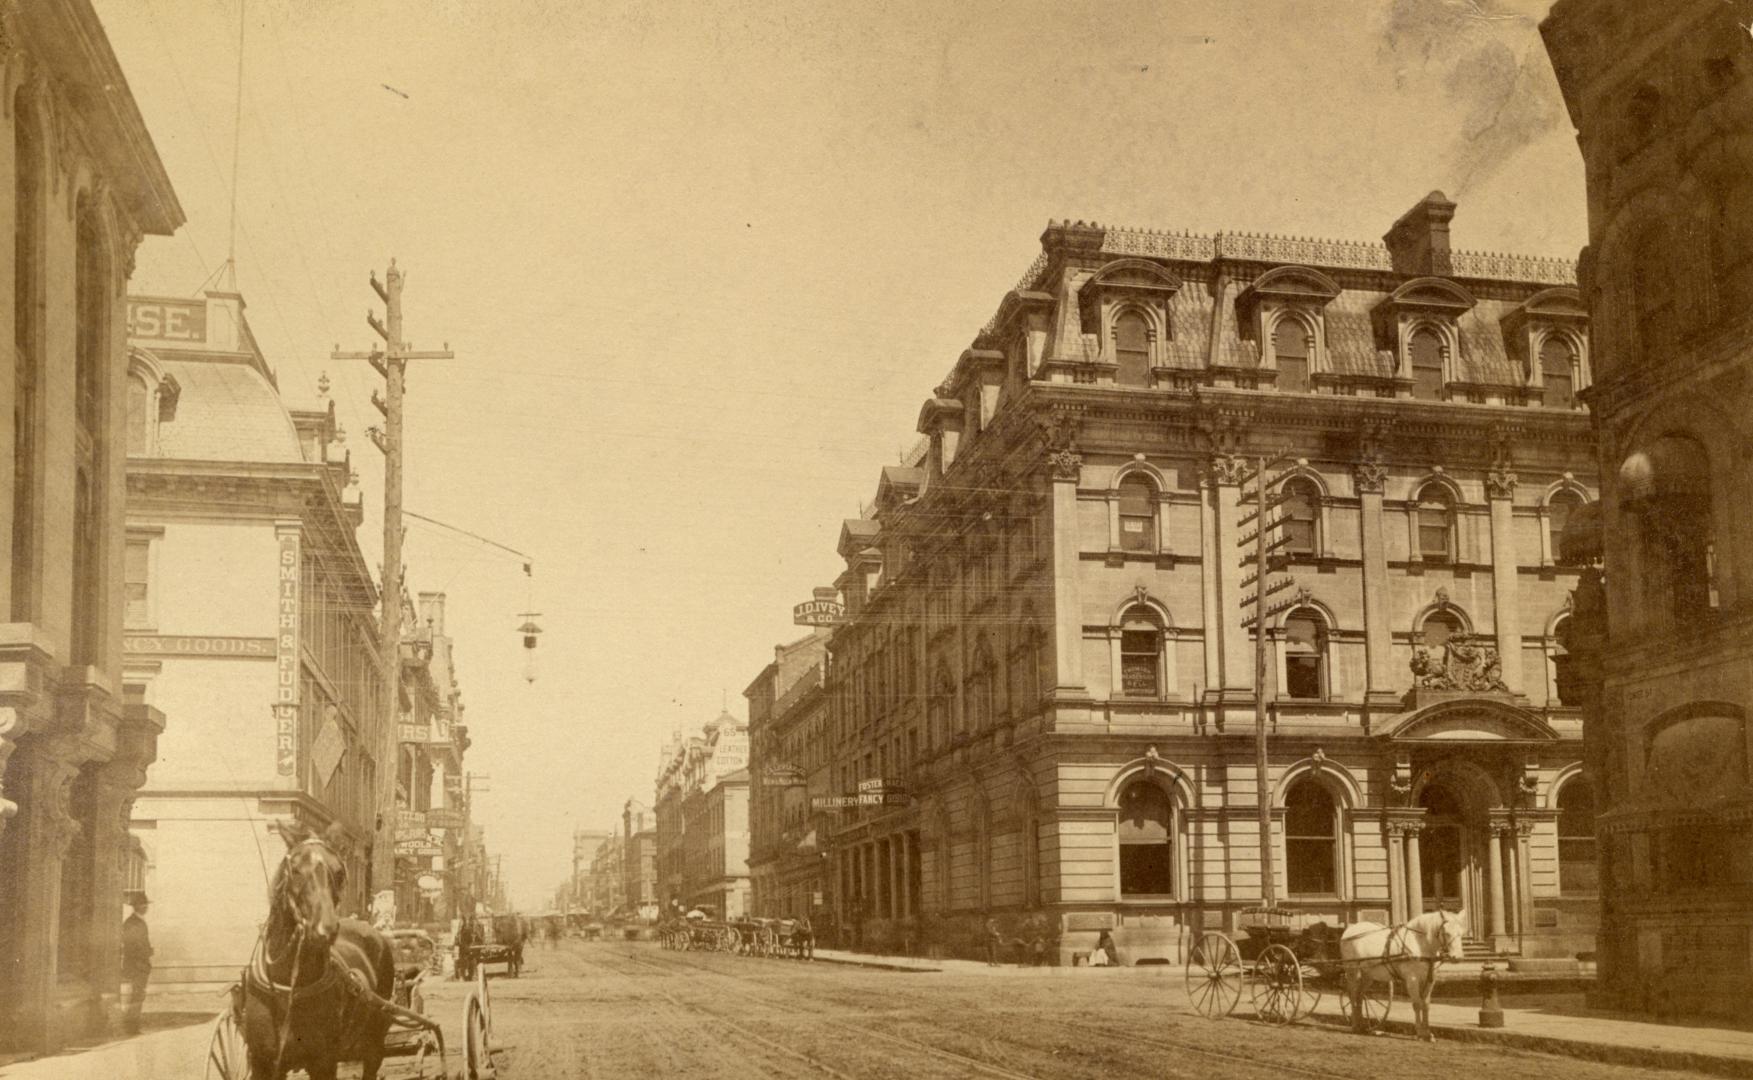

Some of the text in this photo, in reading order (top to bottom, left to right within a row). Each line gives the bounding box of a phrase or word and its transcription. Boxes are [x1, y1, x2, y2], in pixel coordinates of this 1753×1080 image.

[278, 550, 296, 627] SMITH
[807, 615, 816, 623] &
[176, 638, 268, 653] GOODS.
[280, 635, 295, 649] &
[858, 779, 883, 792] FOSTER
[812, 796, 859, 809] MILLINERY
[858, 794, 883, 805] FANCY
